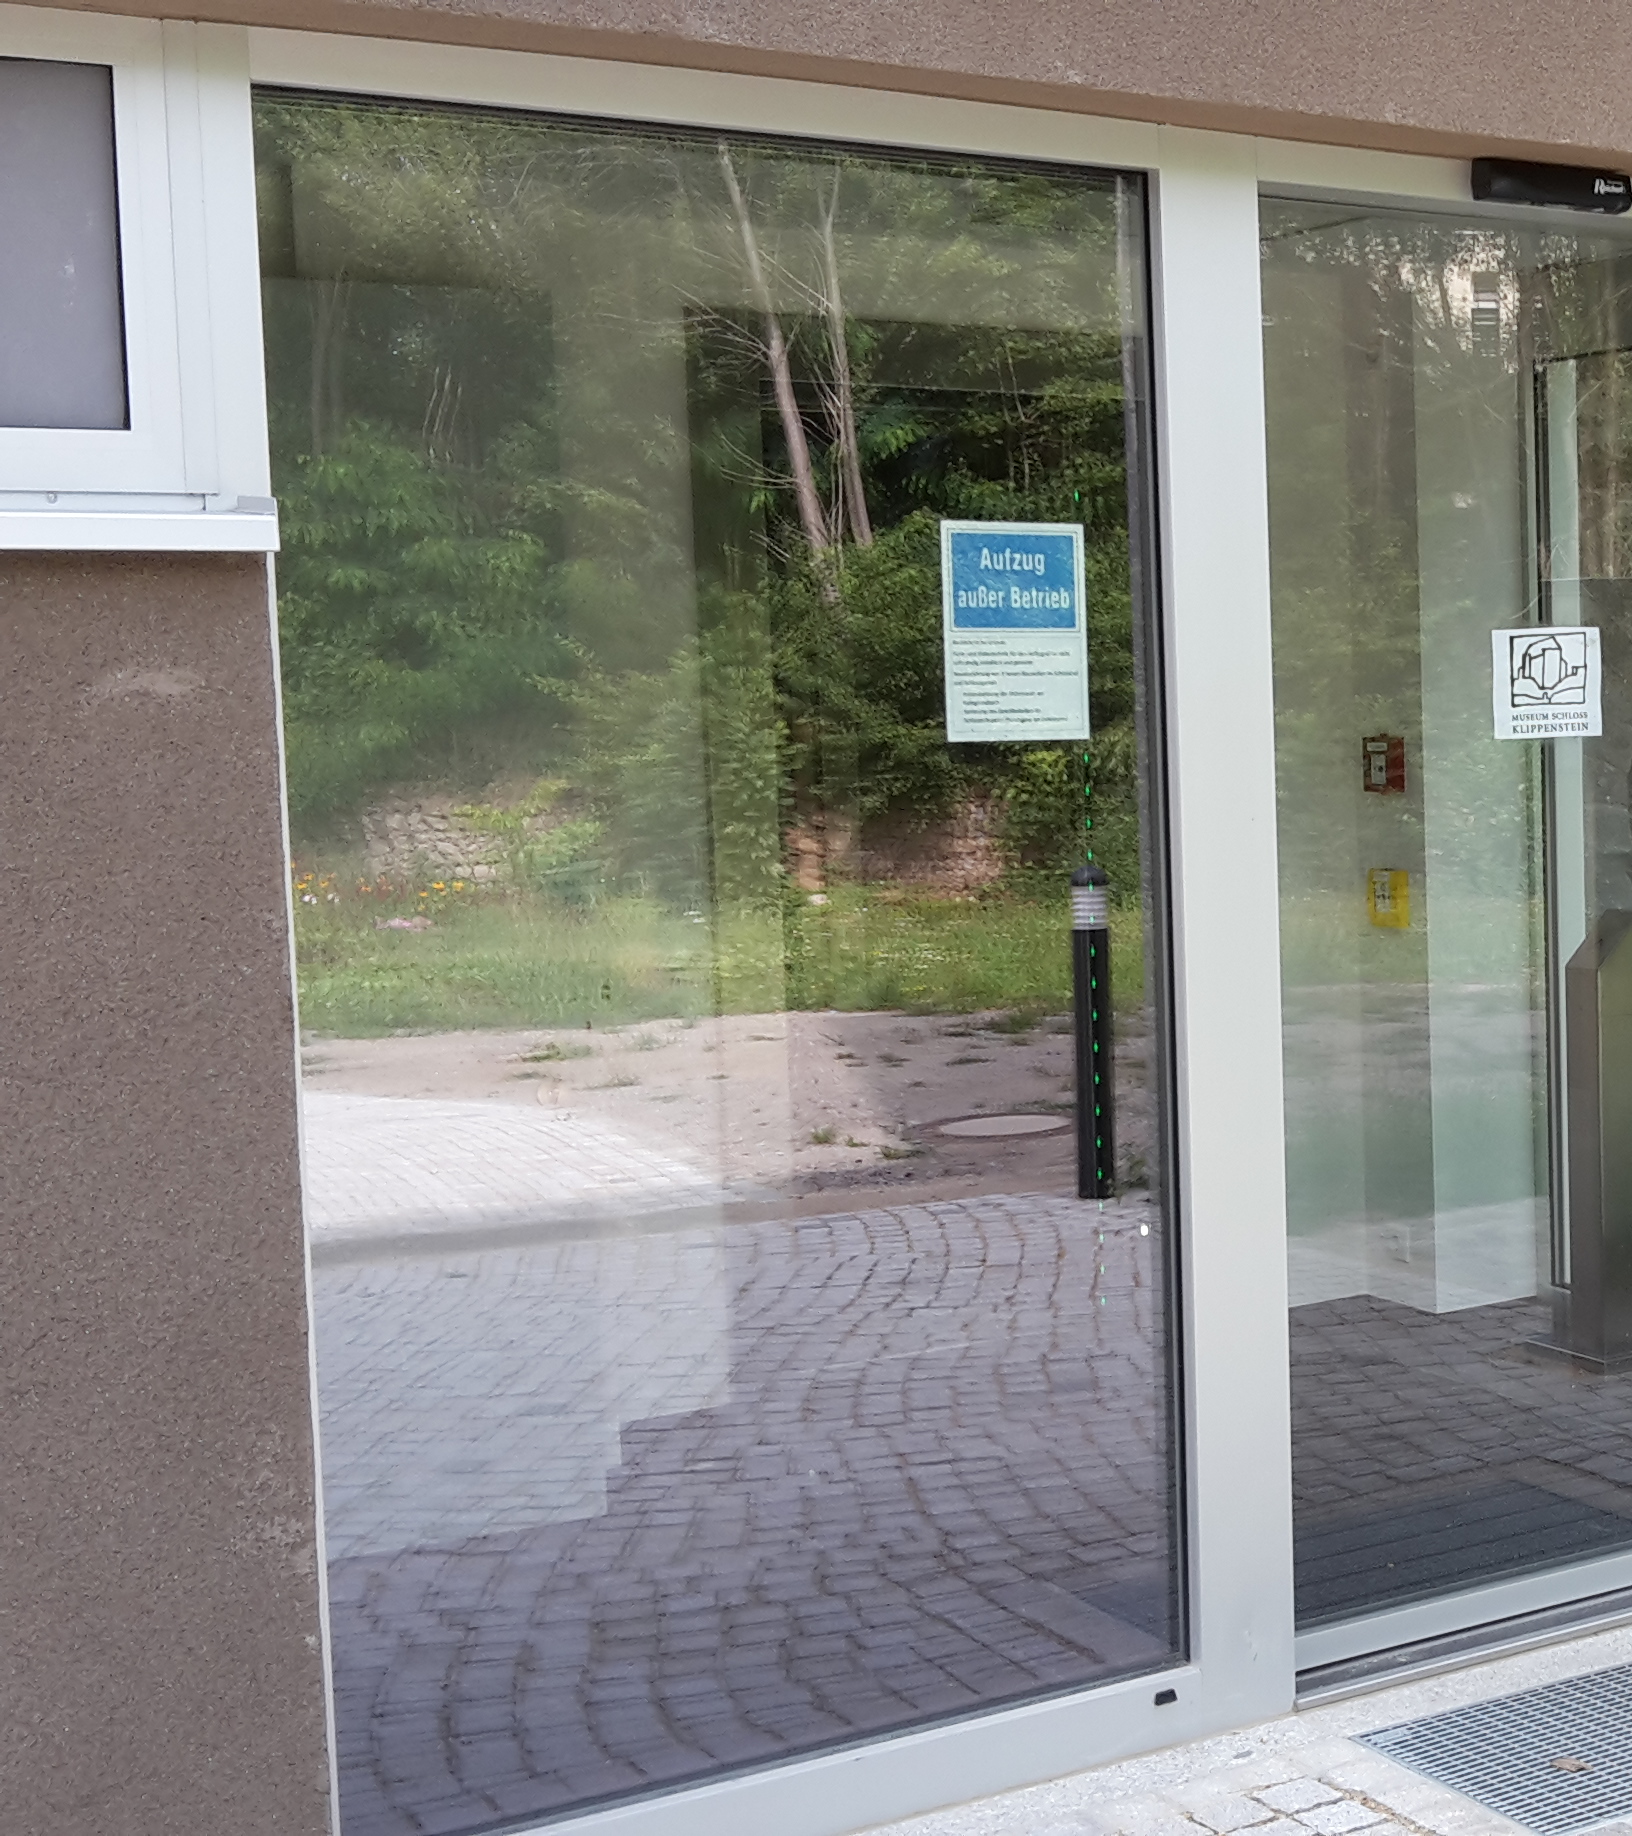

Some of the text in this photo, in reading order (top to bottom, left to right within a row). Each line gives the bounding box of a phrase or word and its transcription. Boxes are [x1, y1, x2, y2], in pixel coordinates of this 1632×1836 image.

[980, 547, 1045, 576] Aufzug
[958, 585, 1070, 609] außer Betrieb
[1511, 711, 1588, 722] MUSEUM SCHLOSS
[1512, 722, 1589, 735] KLIPPENSTEIN
